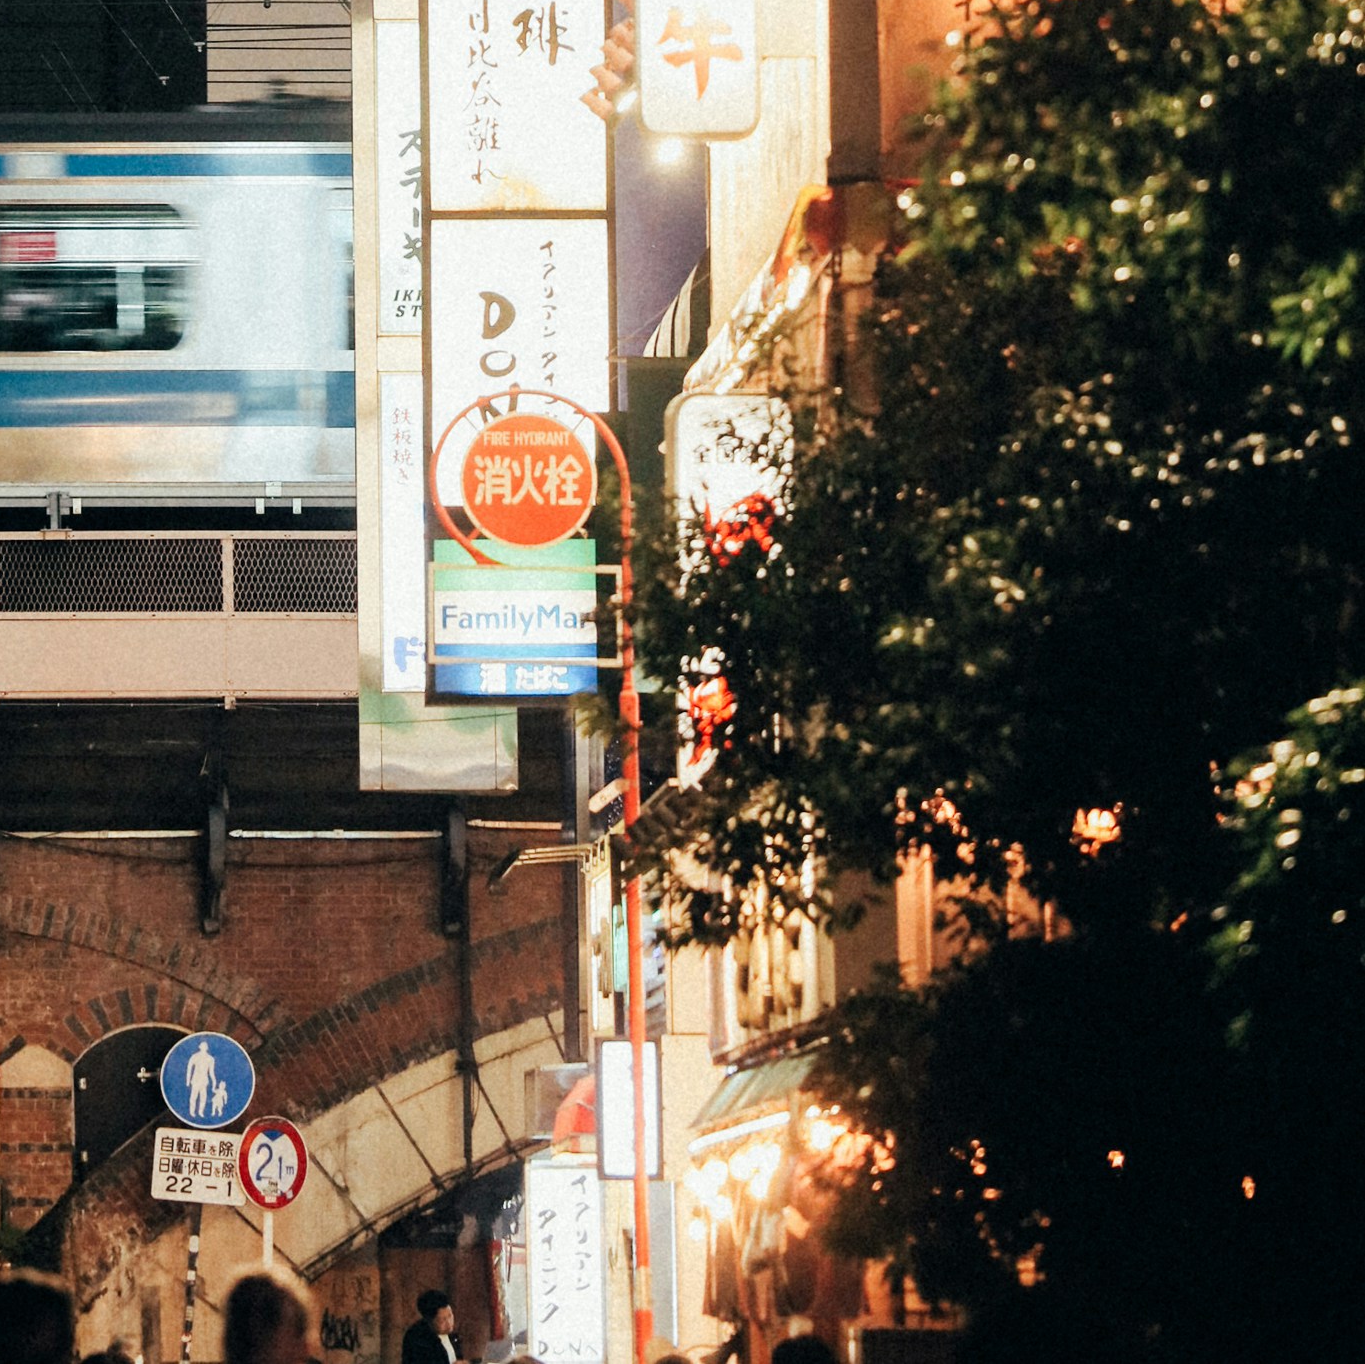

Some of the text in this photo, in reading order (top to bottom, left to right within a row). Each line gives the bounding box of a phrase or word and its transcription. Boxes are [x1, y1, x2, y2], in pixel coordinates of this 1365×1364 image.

[656, 2, 744, 102] 牛
[483, 430, 571, 447] FIRE HYDRANT
[474, 454, 585, 507] 消火栓
[160, 1136, 237, 1158] 自転車を除
